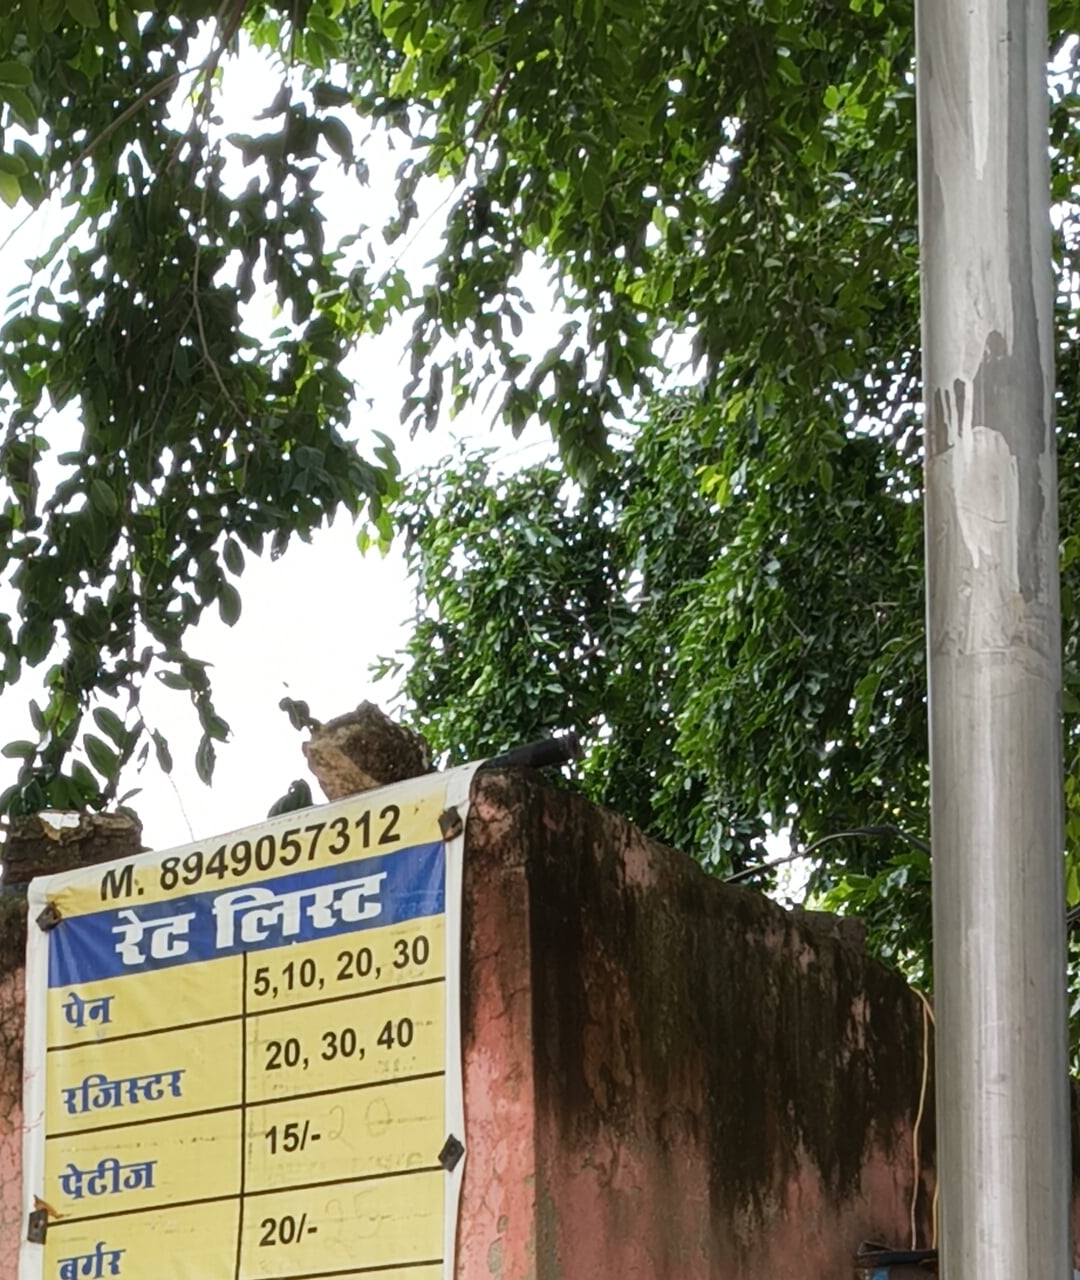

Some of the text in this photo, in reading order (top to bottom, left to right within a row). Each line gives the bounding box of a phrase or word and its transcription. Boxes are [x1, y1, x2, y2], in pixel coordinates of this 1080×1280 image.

[100, 804, 402, 901] M. 8949057312
[112, 872, 387, 966] रेट लिस्ट
[337, 946, 381, 980] 20,
[393, 935, 430, 969] 30
[61, 992, 115, 1028] पेन
[265, 1017, 414, 1072] 20, 30, 40
[61, 1069, 186, 1115] रजिस्टर
[265, 1120, 321, 1155] 15/-
[58, 1158, 158, 1200] पेटीज
[259, 1213, 318, 1247] 20/-
